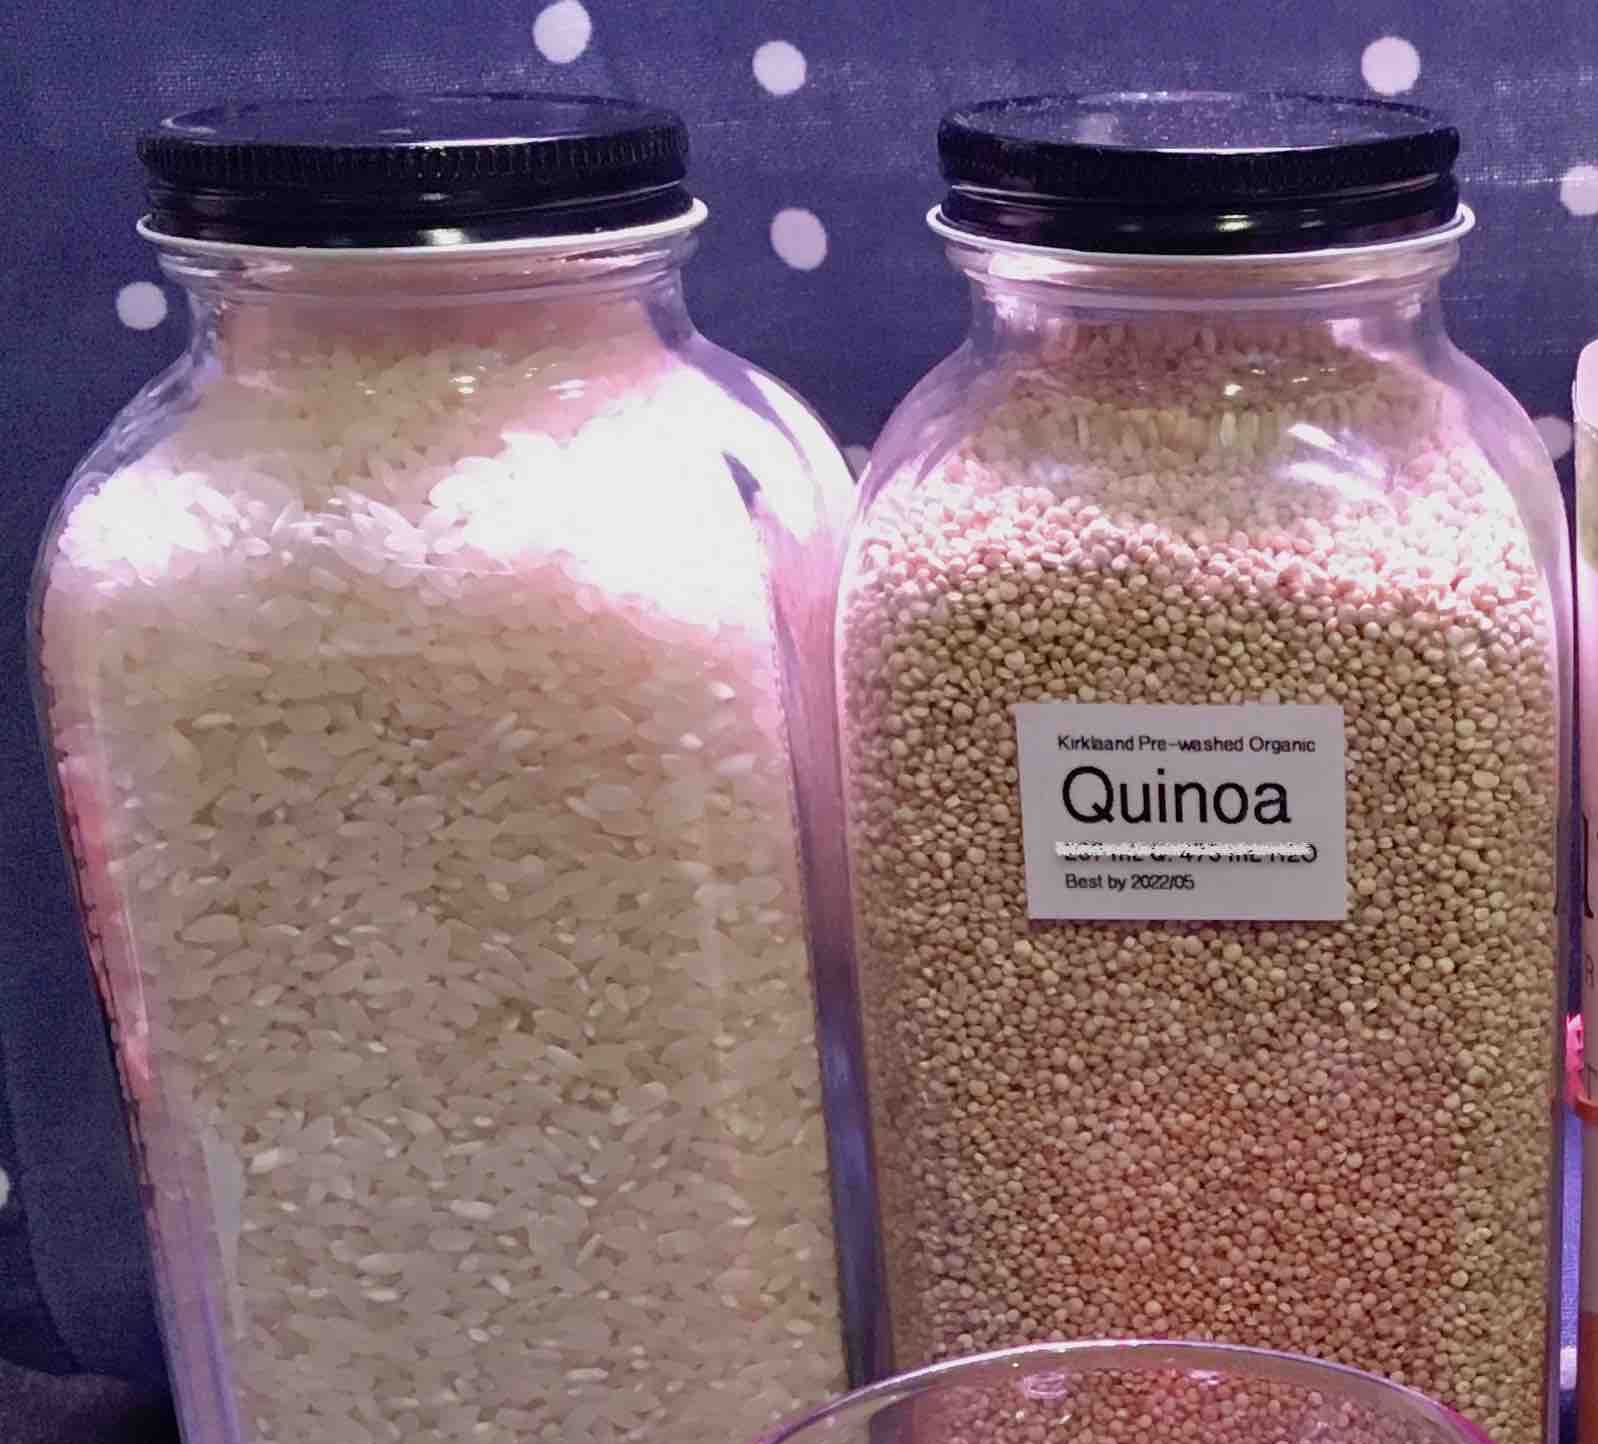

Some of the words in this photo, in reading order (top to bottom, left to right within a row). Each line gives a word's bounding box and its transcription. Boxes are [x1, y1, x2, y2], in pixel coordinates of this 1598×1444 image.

[1139, 736, 1244, 751] Pre-washed
[1249, 736, 1315, 754] Organic
[1062, 766, 1292, 824] Quinoa
[1065, 874, 1103, 889] Best
[1108, 874, 1126, 892] by
[1131, 875, 1195, 890] 2022/05
